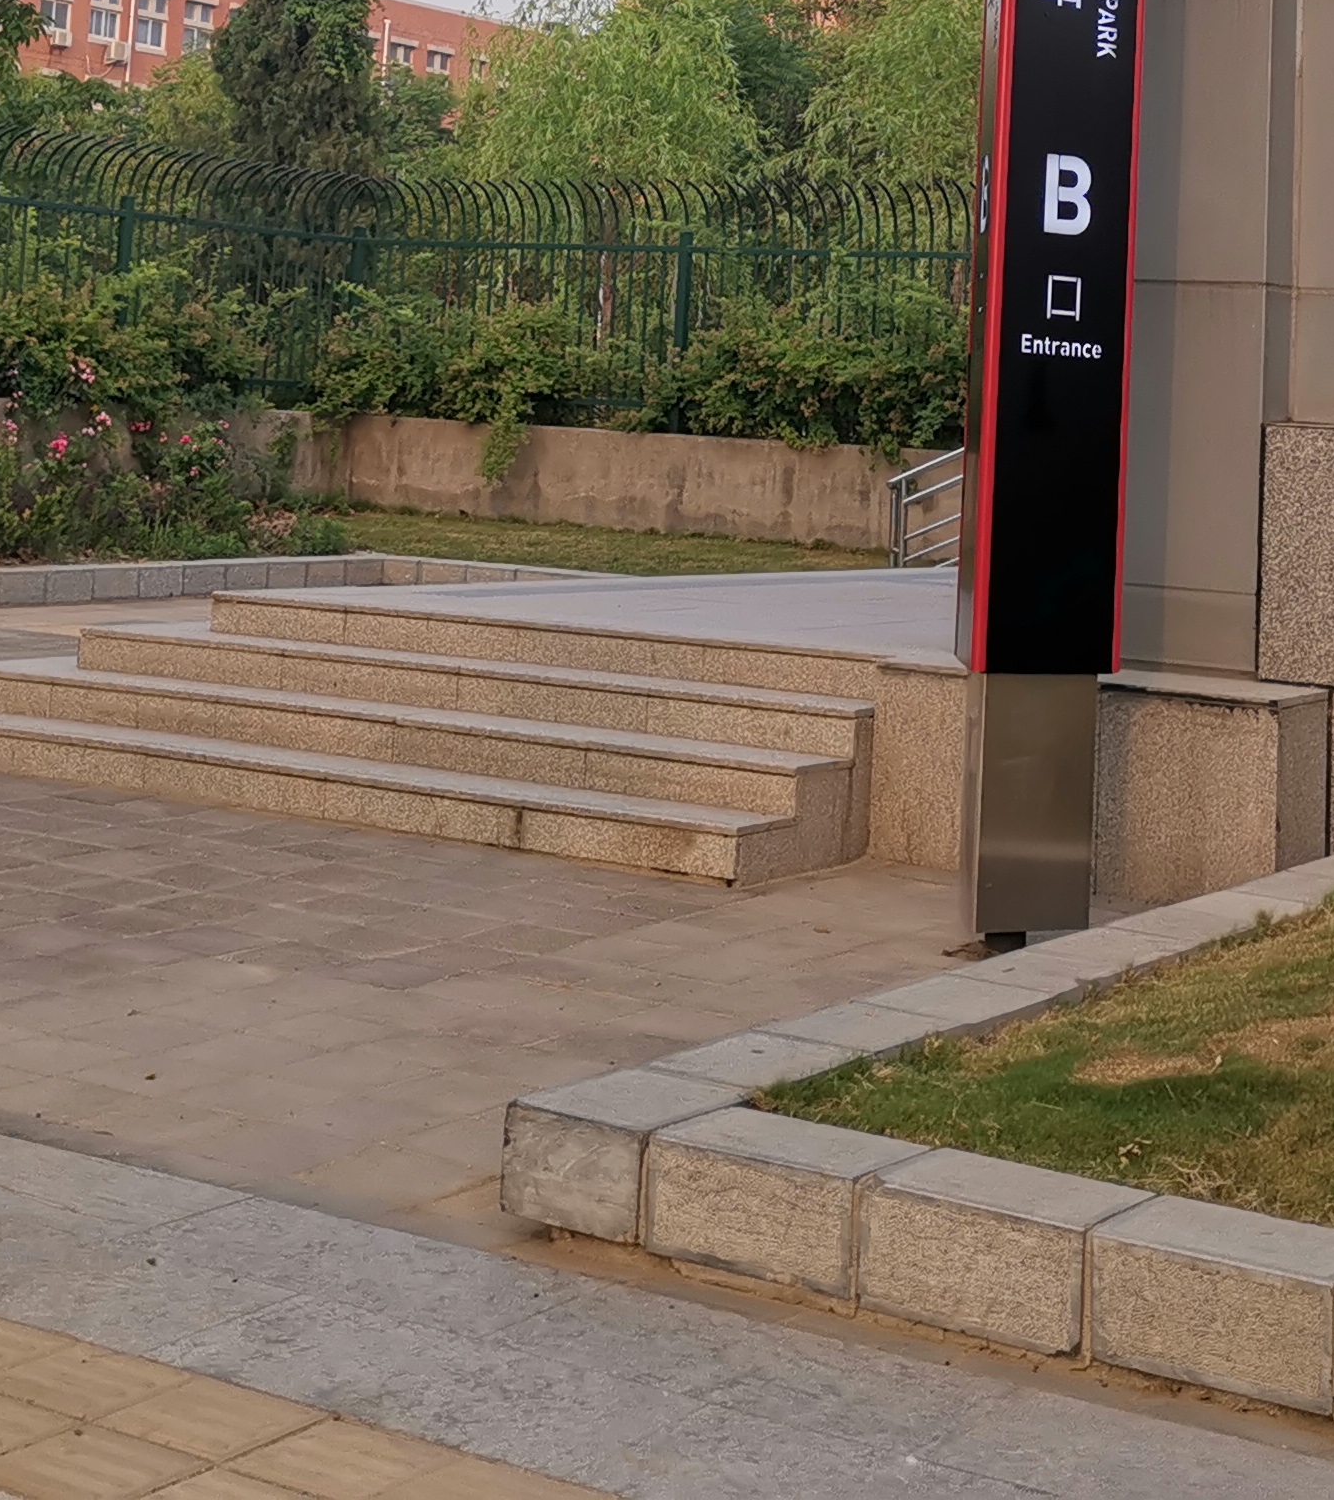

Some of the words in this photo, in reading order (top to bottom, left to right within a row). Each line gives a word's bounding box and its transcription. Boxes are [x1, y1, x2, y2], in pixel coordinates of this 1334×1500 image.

[1043, 153, 1092, 236] B
[1046, 274, 1082, 322] 口
[1021, 333, 1103, 359] Entrance
